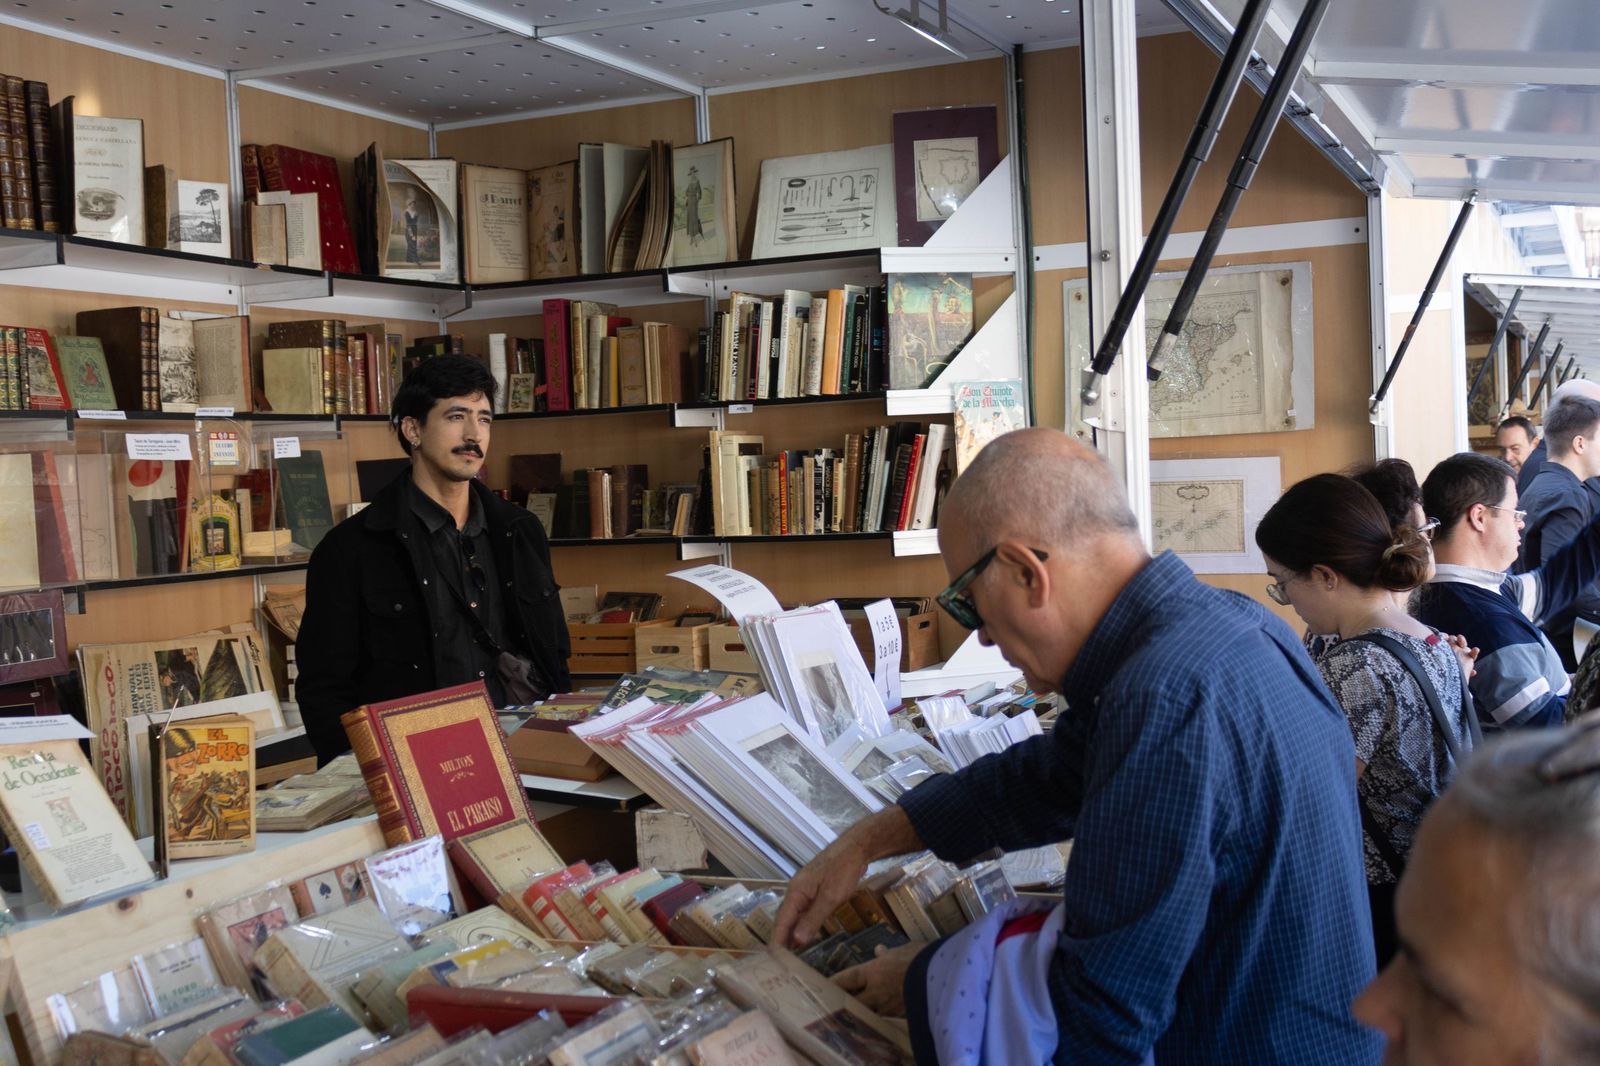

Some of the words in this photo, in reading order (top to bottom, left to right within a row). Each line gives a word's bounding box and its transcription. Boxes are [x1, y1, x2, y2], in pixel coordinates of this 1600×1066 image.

[207, 728, 228, 741] EL
[197, 742, 250, 764] ZORRO
[439, 754, 475, 774] MILTON
[3, 771, 22, 791] de
[447, 809, 465, 832] EL
[463, 796, 504, 827] PARAISO
